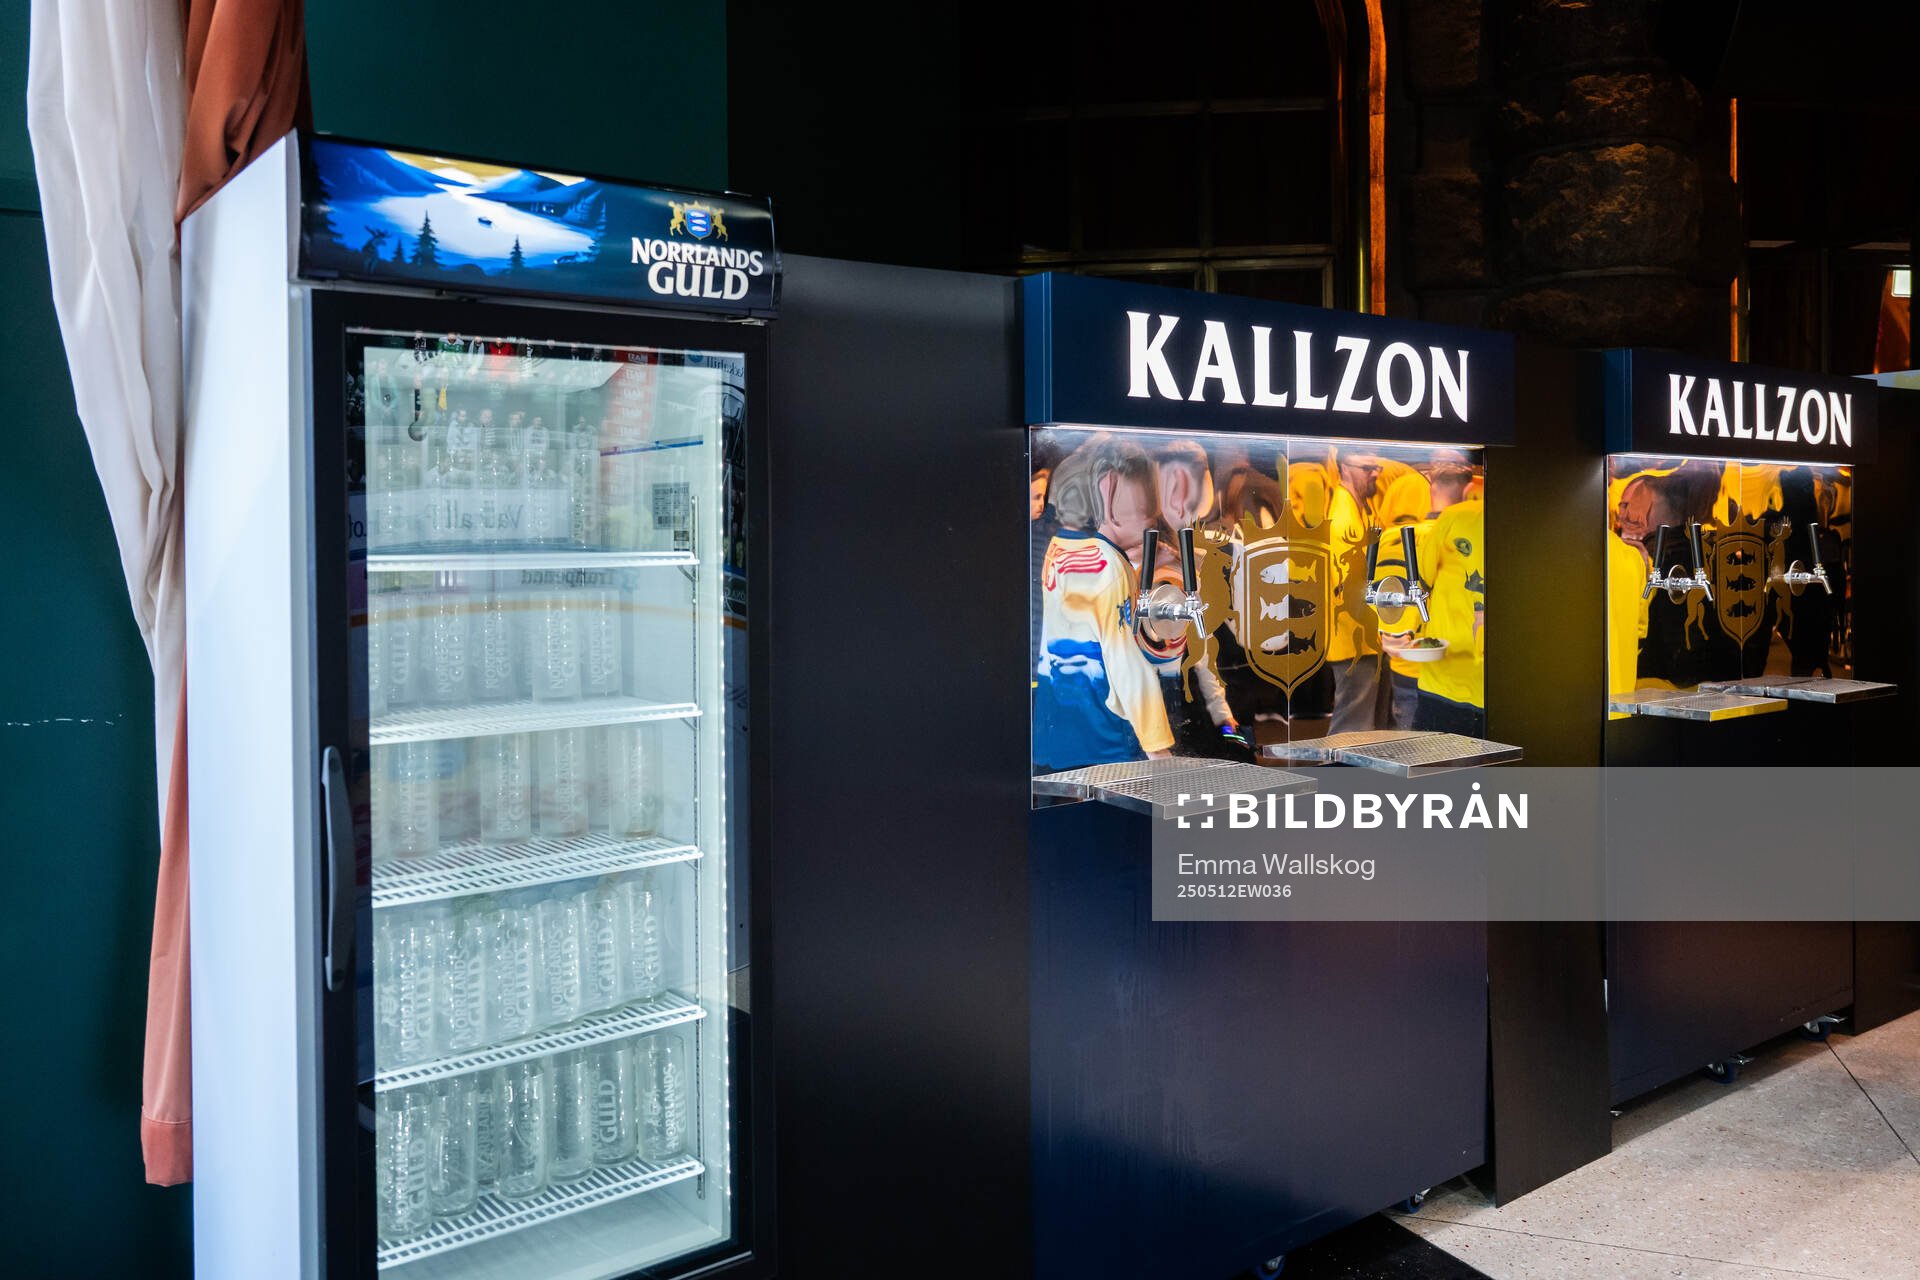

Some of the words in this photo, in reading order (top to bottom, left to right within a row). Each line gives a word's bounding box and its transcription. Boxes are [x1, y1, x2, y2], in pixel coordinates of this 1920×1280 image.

[631, 237, 764, 277] NORRLANDS
[647, 261, 750, 300] GULD
[1126, 310, 1470, 423] KALLZON
[1668, 373, 1853, 448] KALLZON
[549, 609, 564, 689] NORRLANDS
[454, 949, 471, 1040] NORRLANDS
[468, 955, 482, 1026] GULD
[502, 939, 519, 1032] NORRLANDS
[515, 948, 531, 1016] GULD
[548, 928, 566, 1017] NORRLANDS
[562, 935, 577, 1003] GULD
[598, 927, 616, 992] GULD
[401, 959, 419, 1052] NORRLANDS
[416, 966, 433, 1039] GULD
[599, 1079, 617, 1143] GULD
[664, 1063, 679, 1147] NORRLANDS
[408, 1138, 426, 1209] GULD
